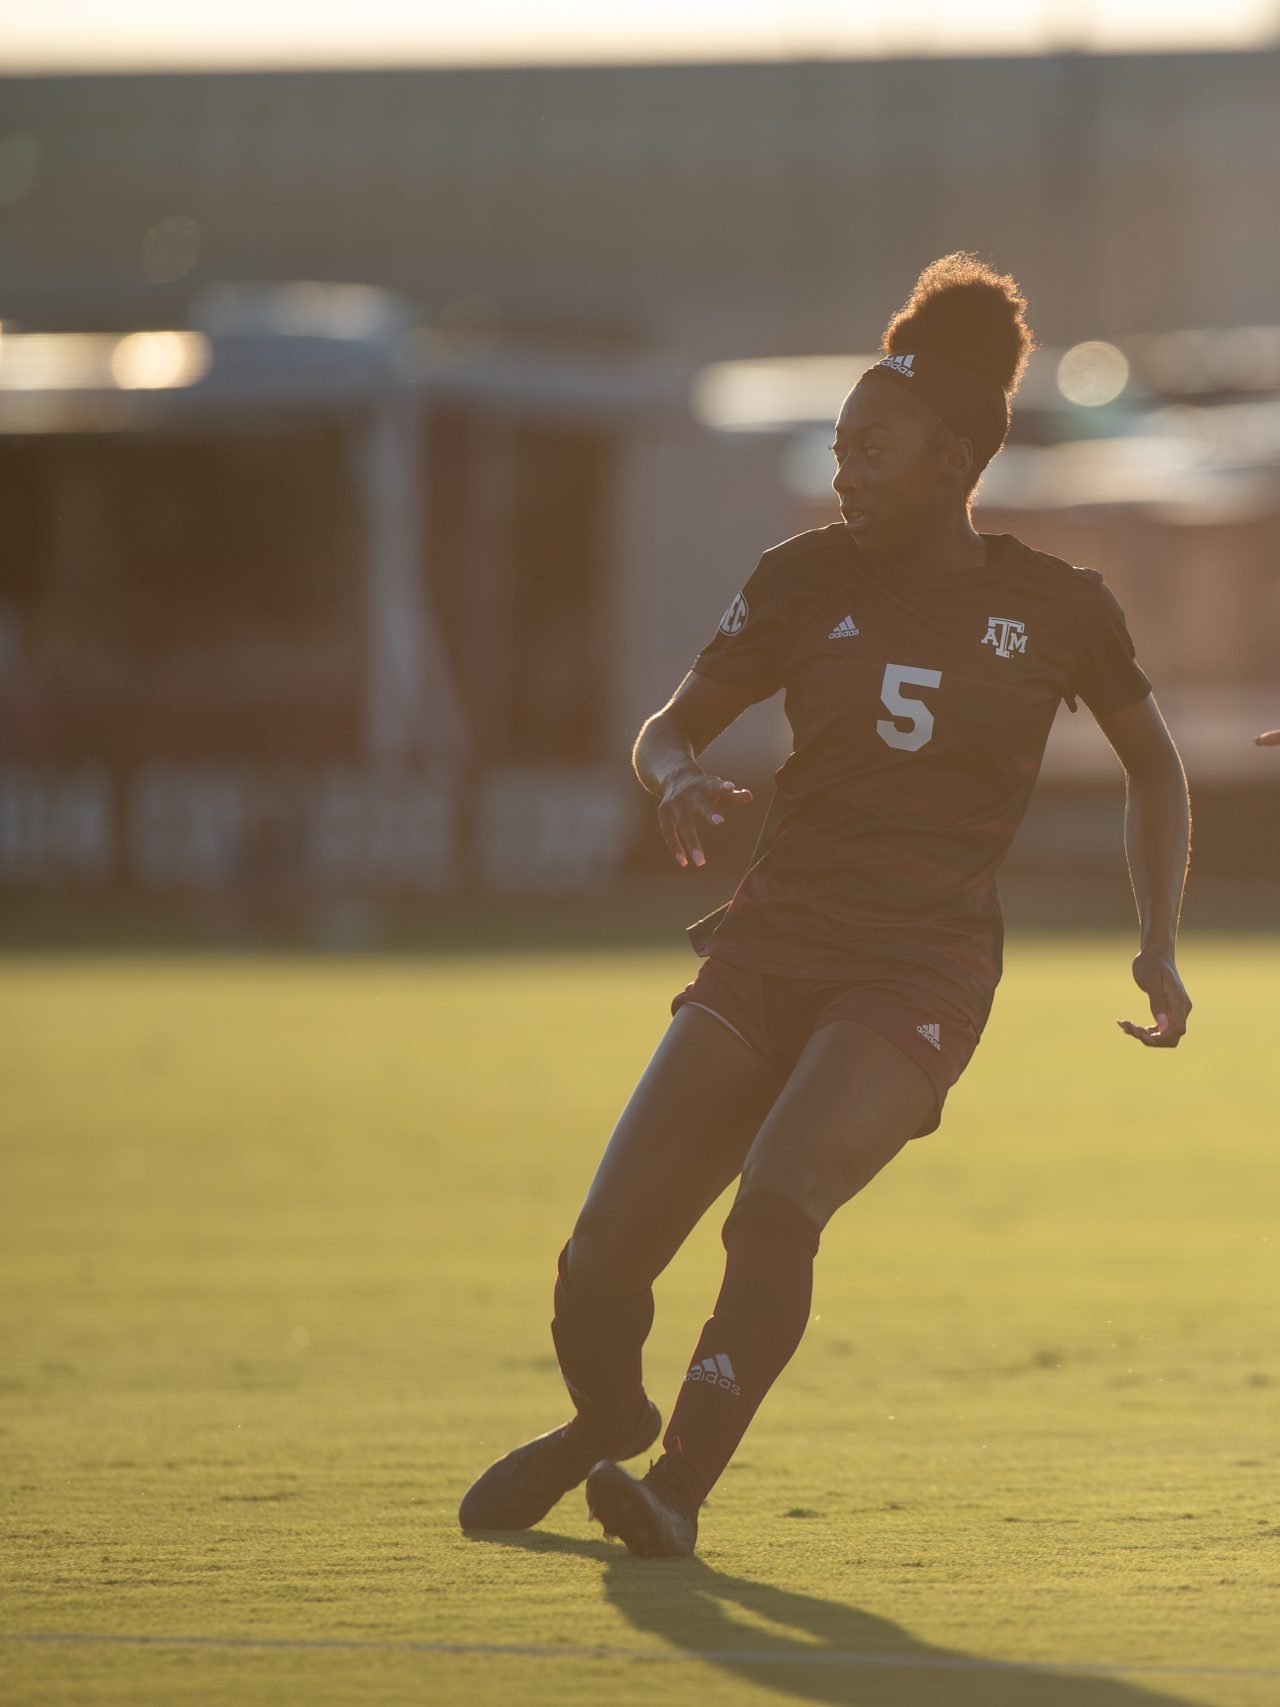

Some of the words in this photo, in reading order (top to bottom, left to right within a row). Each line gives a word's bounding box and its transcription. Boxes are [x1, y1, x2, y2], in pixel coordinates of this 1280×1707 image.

[828, 628, 860, 639] adidas
[876, 663, 943, 752] 5
[916, 1024, 941, 1051] adidas
